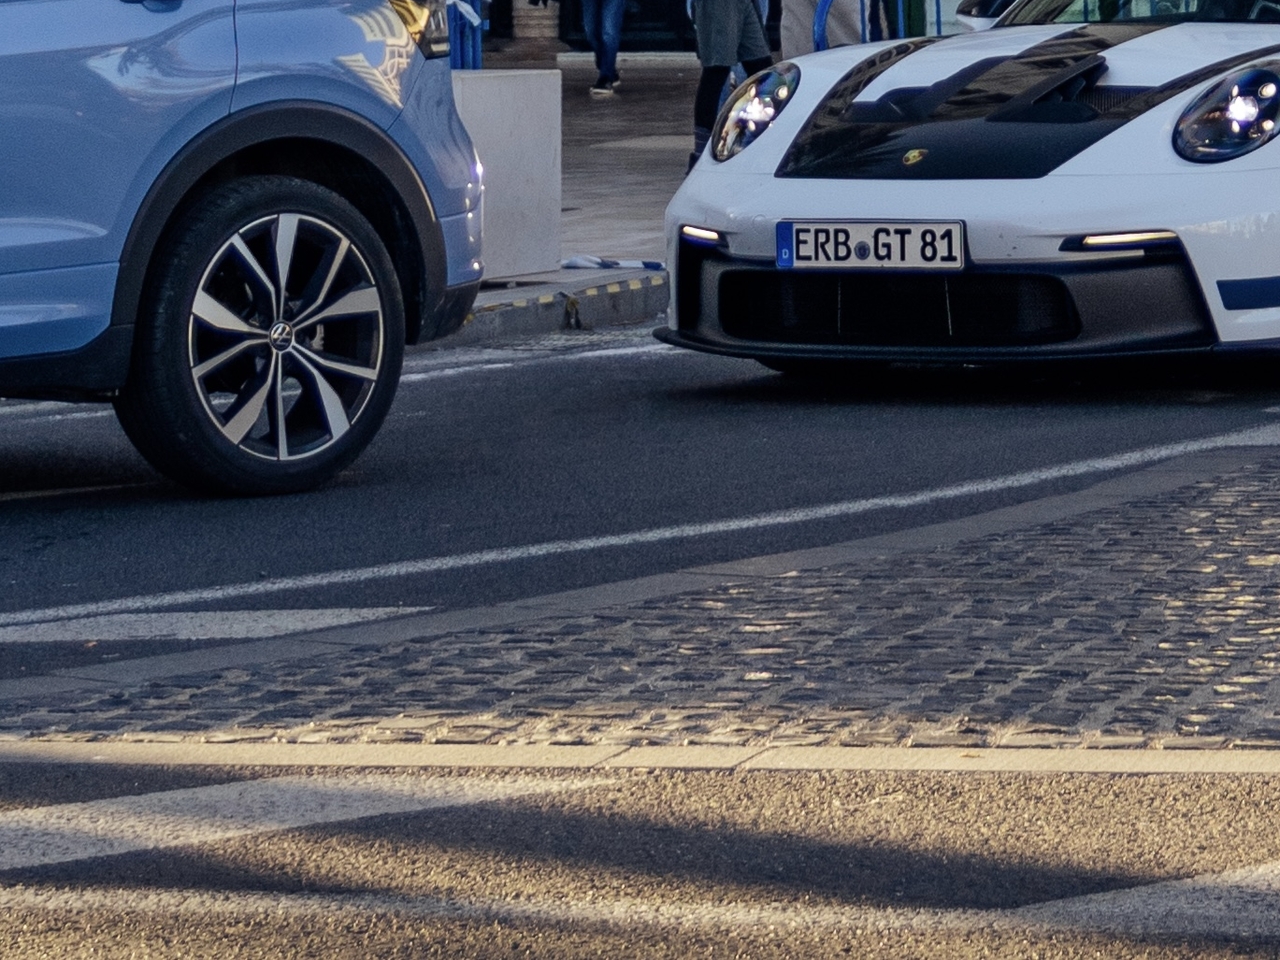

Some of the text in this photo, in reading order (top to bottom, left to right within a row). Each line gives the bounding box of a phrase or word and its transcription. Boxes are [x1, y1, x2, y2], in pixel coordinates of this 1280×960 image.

[795, 227, 852, 261] ERB
[873, 227, 912, 261] GT
[920, 228, 958, 262] 81
